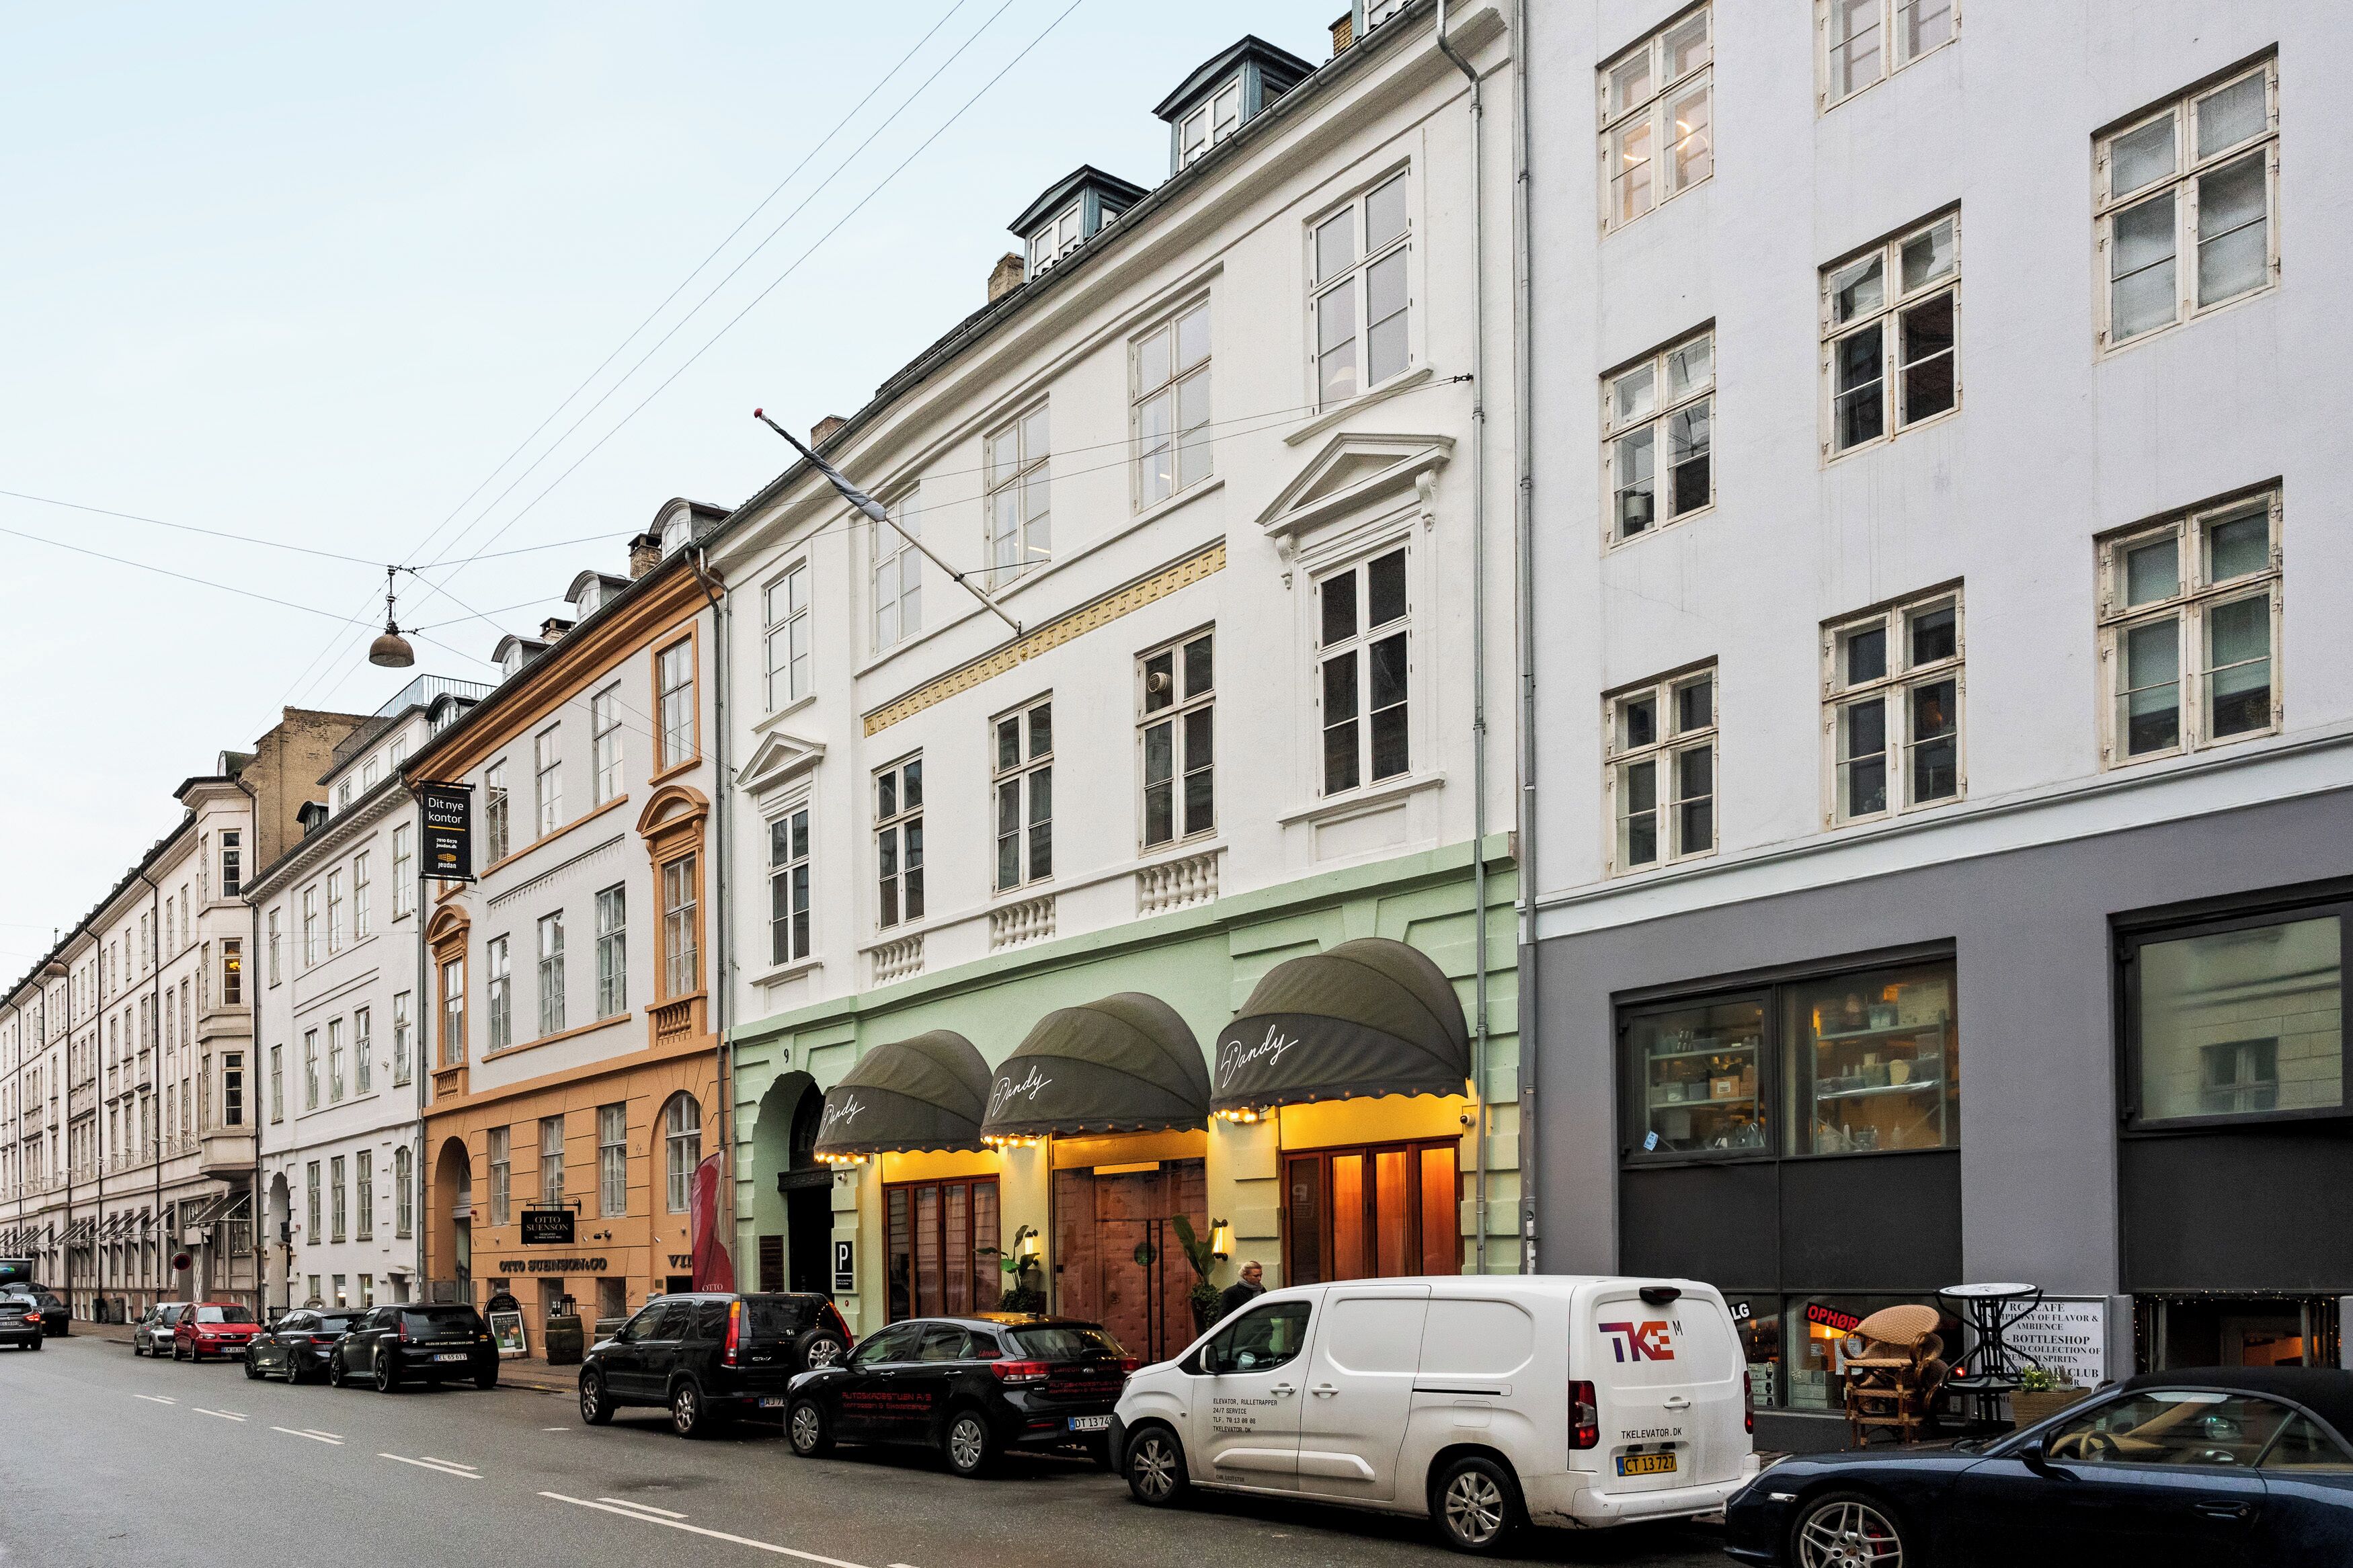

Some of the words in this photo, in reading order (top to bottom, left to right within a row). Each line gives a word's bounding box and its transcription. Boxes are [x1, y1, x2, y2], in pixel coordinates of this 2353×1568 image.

[428, 797, 444, 809] Dit
[446, 802, 464, 813] nye
[428, 811, 463, 824] kontor
[783, 1048, 789, 1064] 9
[1220, 1024, 1299, 1089] Dandy
[992, 1065, 1052, 1118] Dandy
[820, 1094, 866, 1139] Dandy
[534, 1216, 561, 1224] OTTO
[526, 1223, 569, 1231] SUENSON
[839, 1244, 848, 1270] P
[499, 1260, 526, 1273] OTTO
[702, 1284, 723, 1292] OTTO
[1730, 1303, 1750, 1320] LG
[2009, 1303, 2026, 1311] RC
[2034, 1302, 2065, 1312] CAFÉ
[1807, 1305, 1862, 1331] OPHØR
[1672, 1320, 1683, 1335] M
[2016, 1323, 2064, 1331] AMBIENCE
[1597, 1321, 1675, 1362] TKE
[2012, 1334, 2091, 1345] BOTTLESHOP
[2028, 1345, 2087, 1354] COLLECTION
[2089, 1347, 2102, 1355] OF
[2043, 1355, 2078, 1363] SPIRITS
[2069, 1367, 2099, 1378] CLUB
[1075, 1419, 1086, 1428] DT
[1088, 1417, 1099, 1427] 13
[1213, 1426, 1252, 1434] TKELEVATOR.DK
[1621, 1428, 1682, 1439] TKELEVATOR.DK
[1625, 1460, 1639, 1472] CT
[1642, 1458, 1654, 1471] 13
[1657, 1456, 1675, 1469] 727
